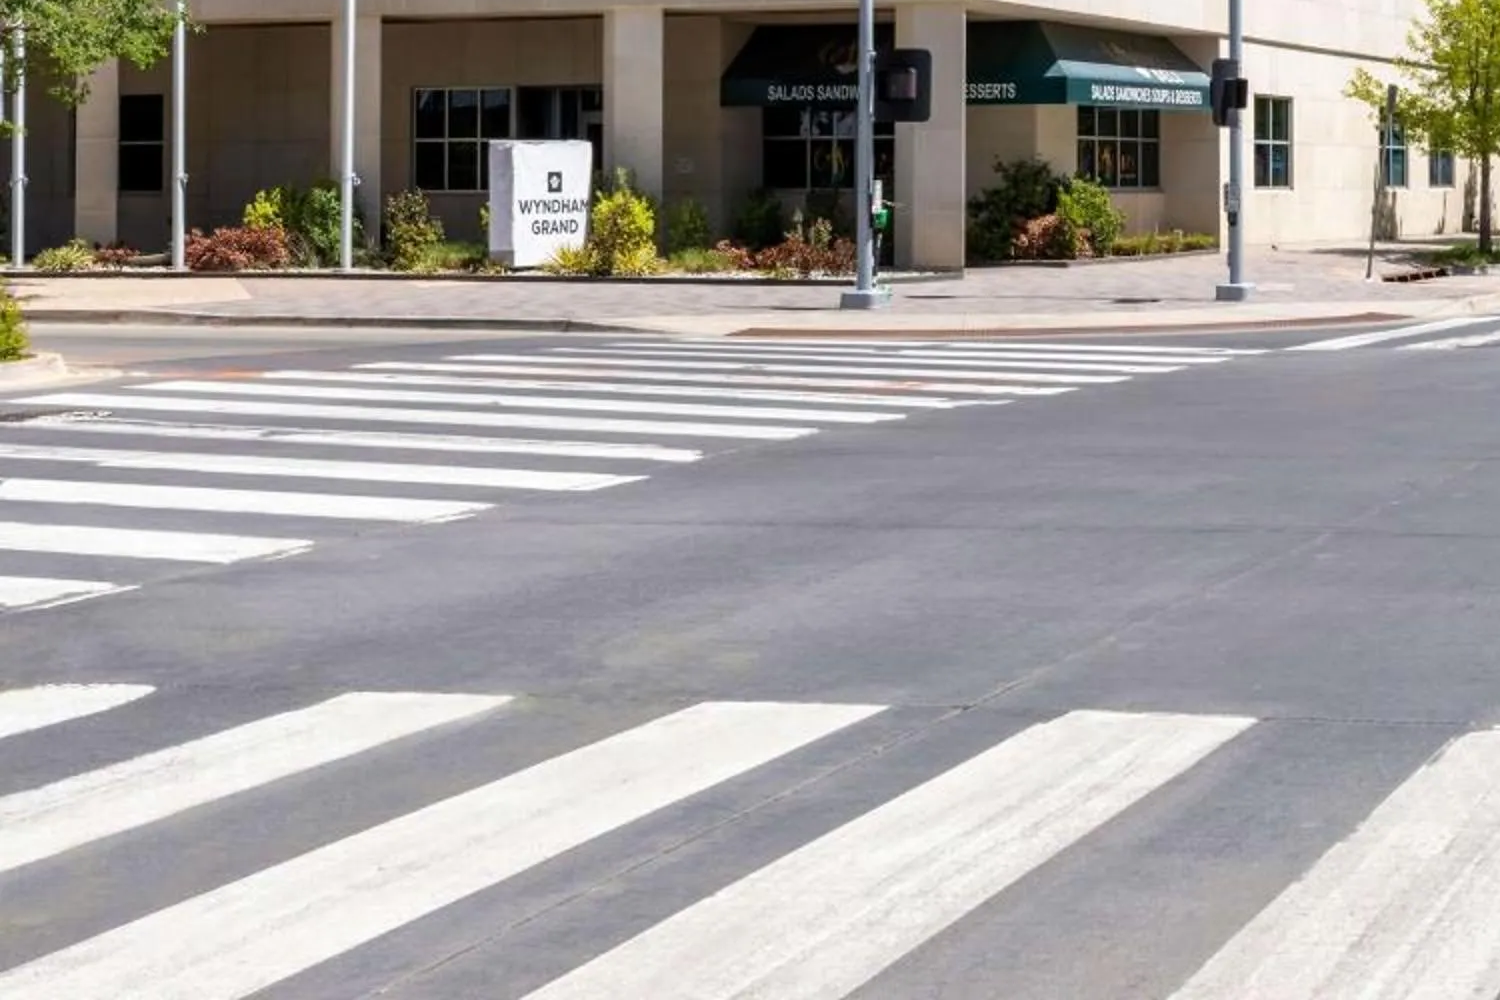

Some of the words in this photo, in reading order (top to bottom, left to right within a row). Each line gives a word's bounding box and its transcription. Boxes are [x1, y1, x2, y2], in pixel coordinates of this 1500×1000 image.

[767, 84, 815, 101] SALADS
[816, 84, 860, 101] SANDW
[518, 199, 588, 215] WYNDHAM
[531, 219, 578, 235] GRAND
